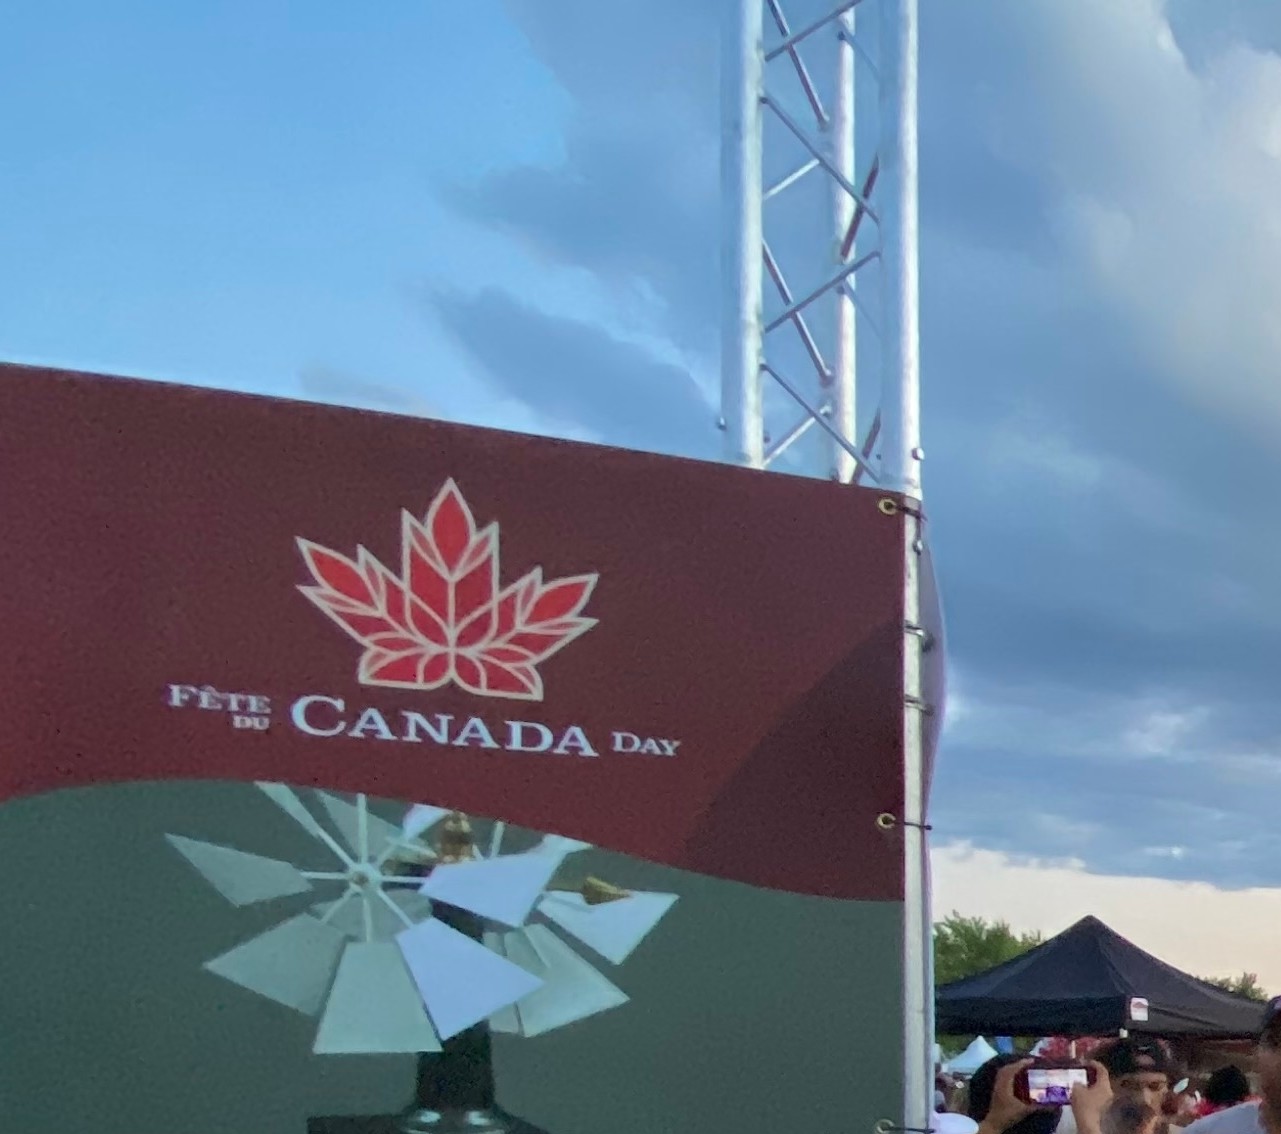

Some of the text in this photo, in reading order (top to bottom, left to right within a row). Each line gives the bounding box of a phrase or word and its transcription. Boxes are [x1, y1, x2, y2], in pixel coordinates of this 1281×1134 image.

[168, 685, 681, 757] FÊTE DU CANADA DAY
